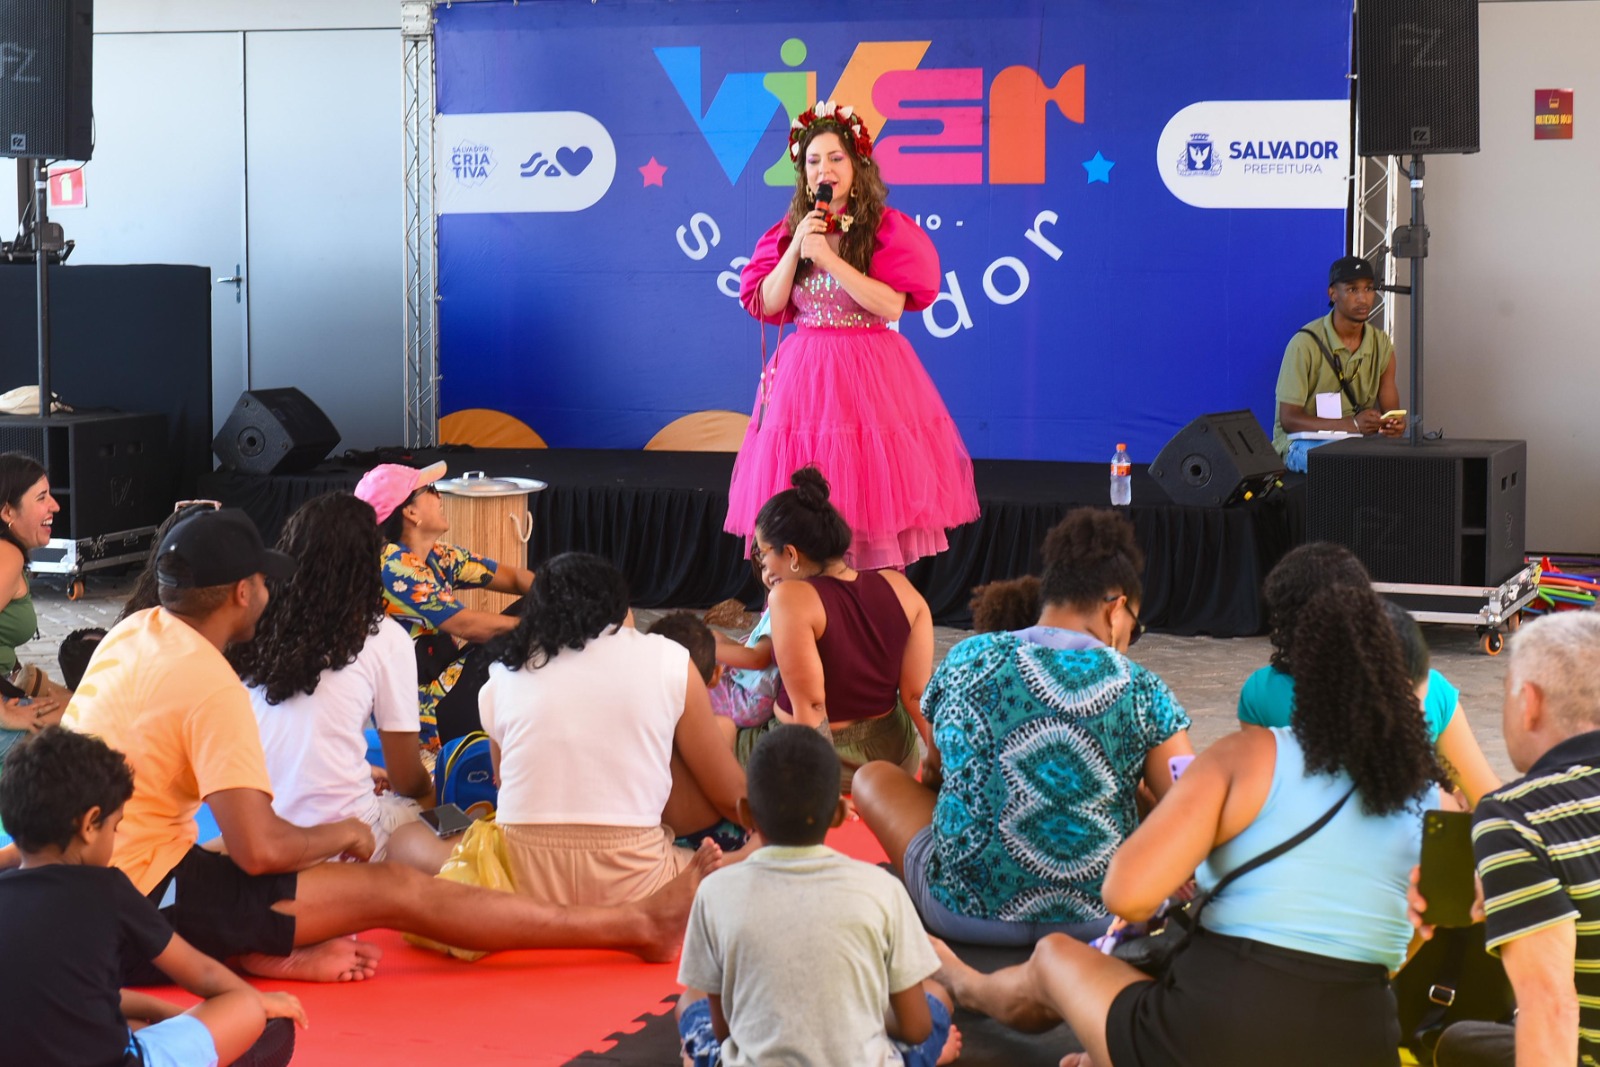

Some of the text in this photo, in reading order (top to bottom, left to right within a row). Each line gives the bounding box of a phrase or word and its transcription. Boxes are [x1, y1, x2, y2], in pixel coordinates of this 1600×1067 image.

[1229, 141, 1339, 159] SALVADOR
[451, 153, 490, 166] CRIA
[453, 166, 489, 179] TIVA
[1243, 163, 1323, 175] PREFEITURA
